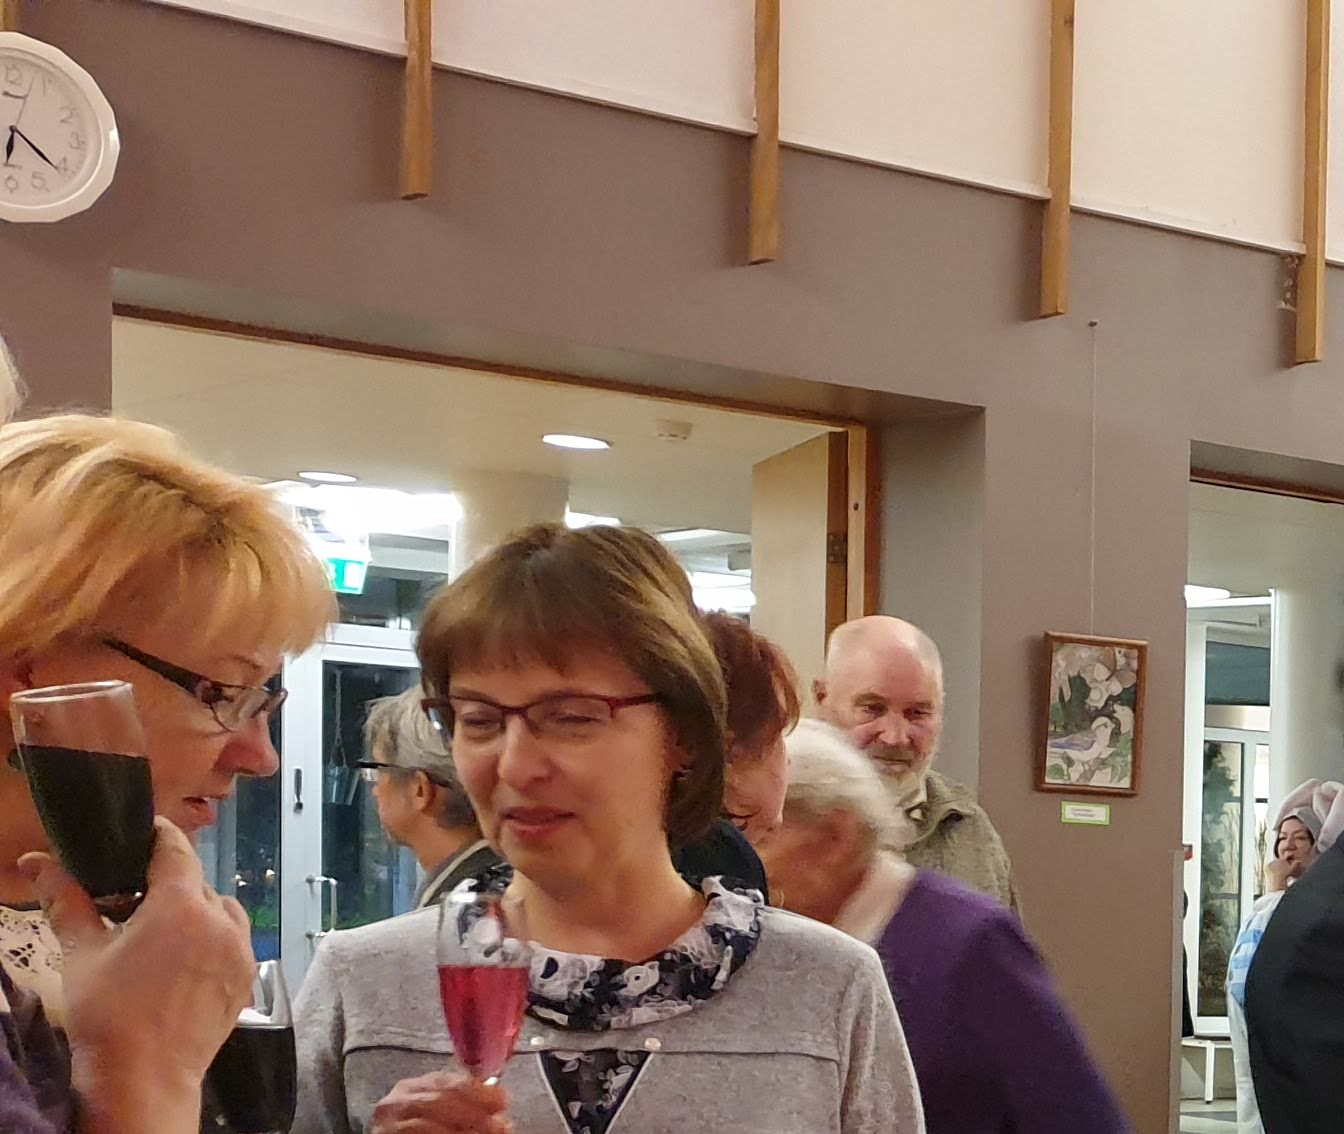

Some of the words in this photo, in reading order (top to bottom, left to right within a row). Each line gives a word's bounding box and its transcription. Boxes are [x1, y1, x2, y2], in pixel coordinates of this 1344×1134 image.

[58, 105, 73, 124] 2
[68, 131, 81, 150] 3
[31, 171, 46, 191] 5
